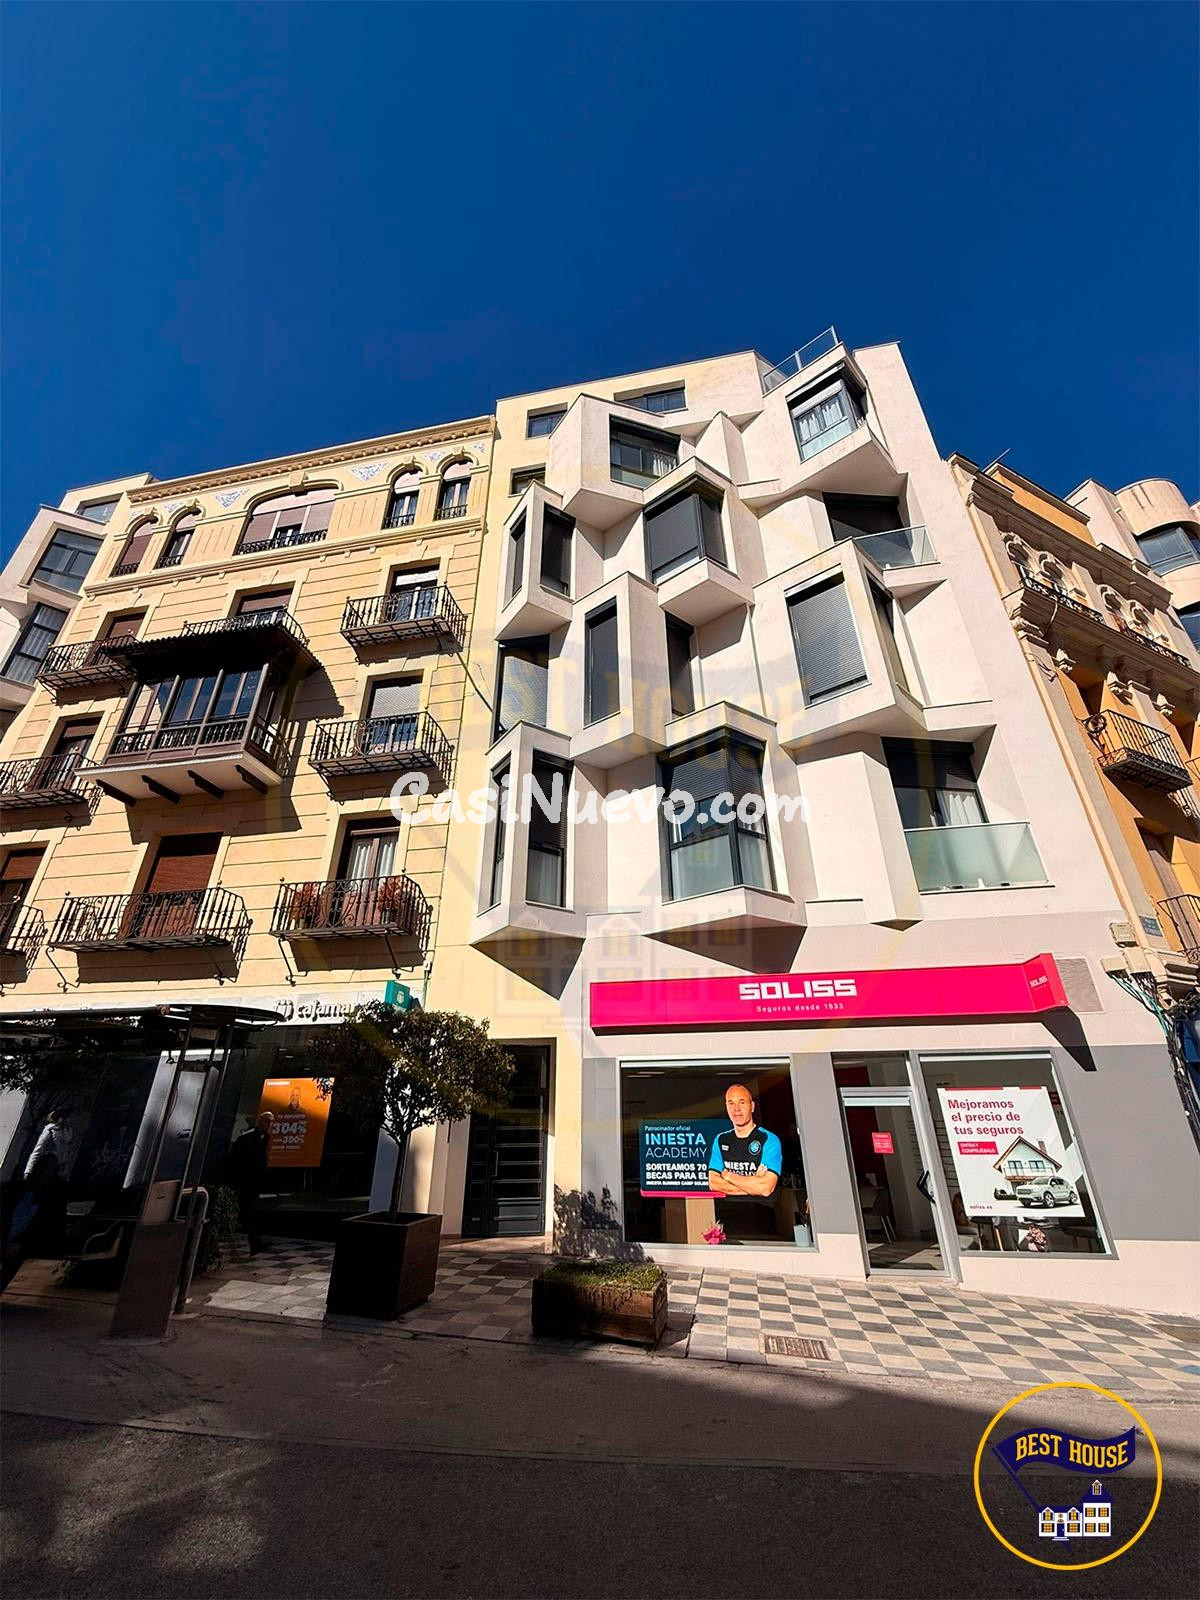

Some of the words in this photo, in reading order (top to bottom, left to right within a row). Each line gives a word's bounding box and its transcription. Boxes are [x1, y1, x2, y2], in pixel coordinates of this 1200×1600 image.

[739, 979, 857, 1000] SOLISS
[756, 1005, 792, 1013] Seguros
[948, 1099, 1014, 1111] Mejoramos
[951, 1112, 961, 1122] el
[965, 1112, 1003, 1123] precio
[1006, 1111, 1020, 1121] de
[954, 1125, 973, 1135] tus
[976, 1126, 1024, 1136] seguros
[645, 1133, 706, 1145] INIESTA
[645, 1147, 707, 1158] ACADEMY
[645, 1163, 695, 1171] SORTEAMOS
[696, 1163, 707, 1171] 70
[646, 1172, 673, 1180] BECAS
[674, 1172, 697, 1180] PARA
[698, 1172, 708, 1180] EL
